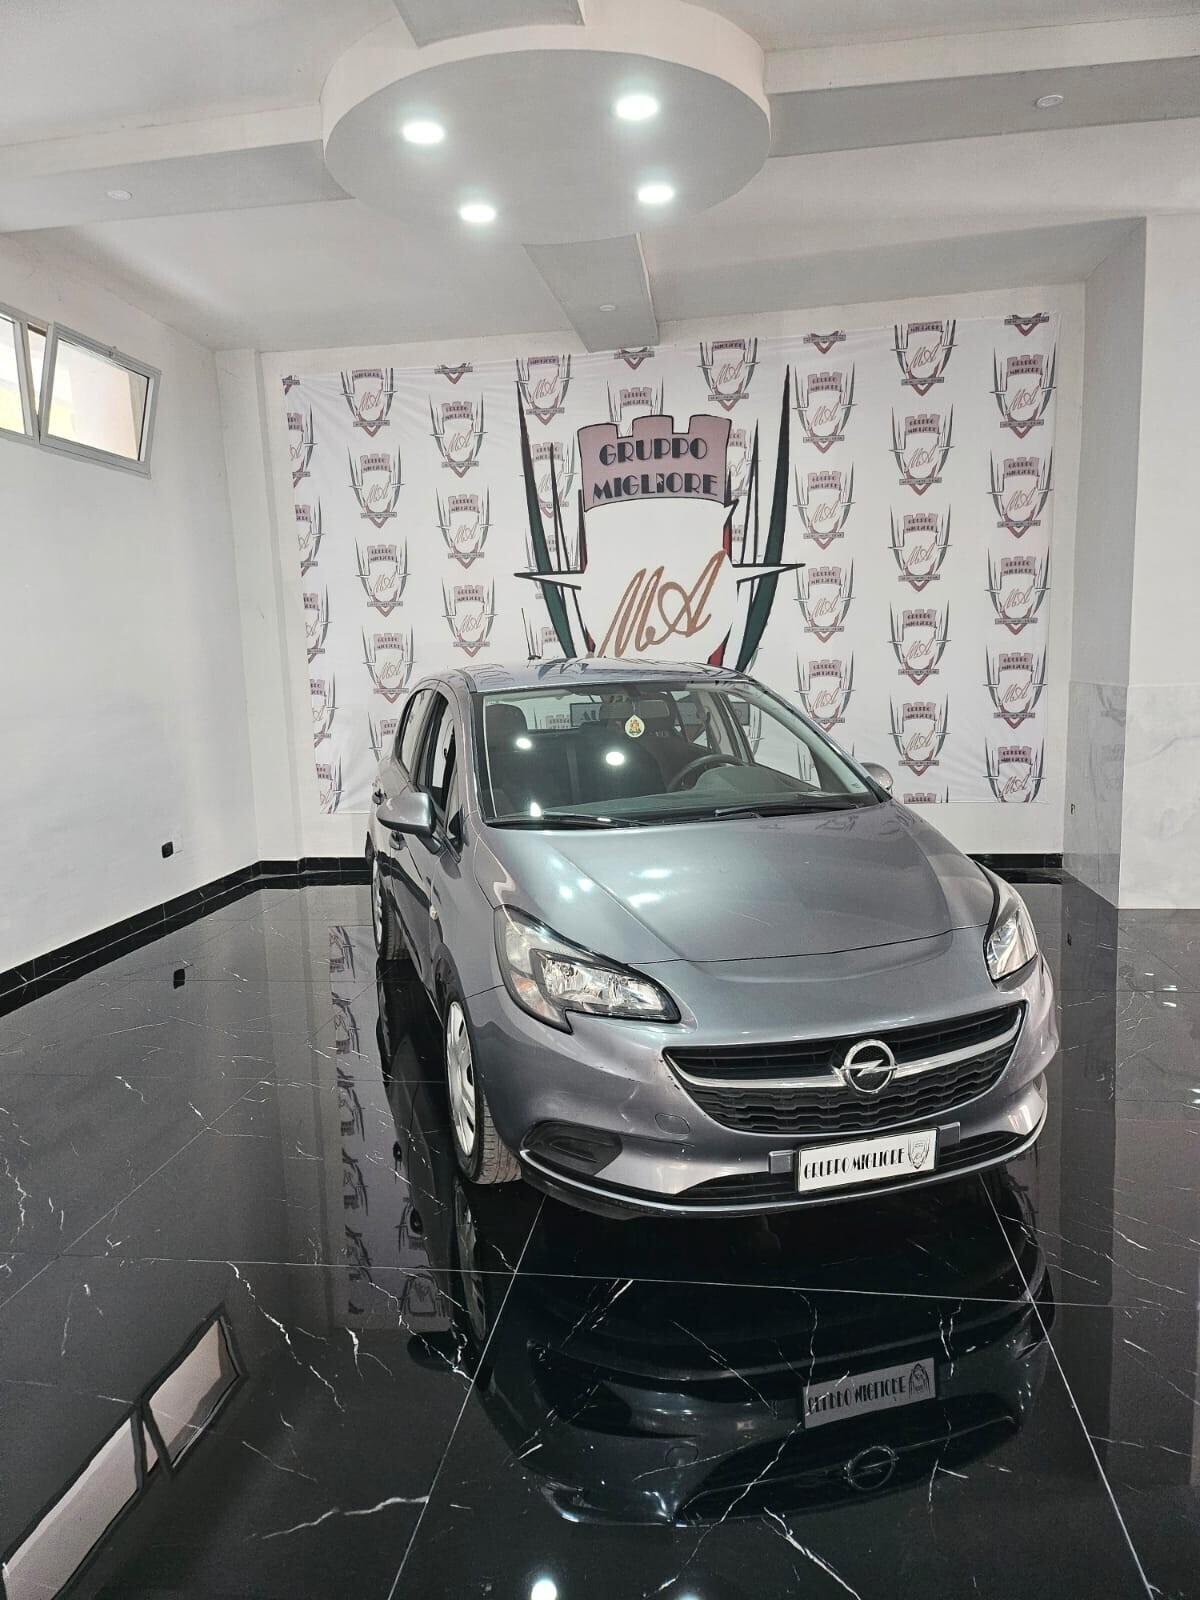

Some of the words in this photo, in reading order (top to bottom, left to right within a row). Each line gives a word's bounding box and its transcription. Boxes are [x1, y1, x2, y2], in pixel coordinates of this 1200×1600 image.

[598, 436, 709, 467] GRUPPO
[592, 472, 719, 501] MIGLIORE
[804, 1156, 850, 1180] GRUPPO
[852, 1147, 906, 1171] MIGLIORE
